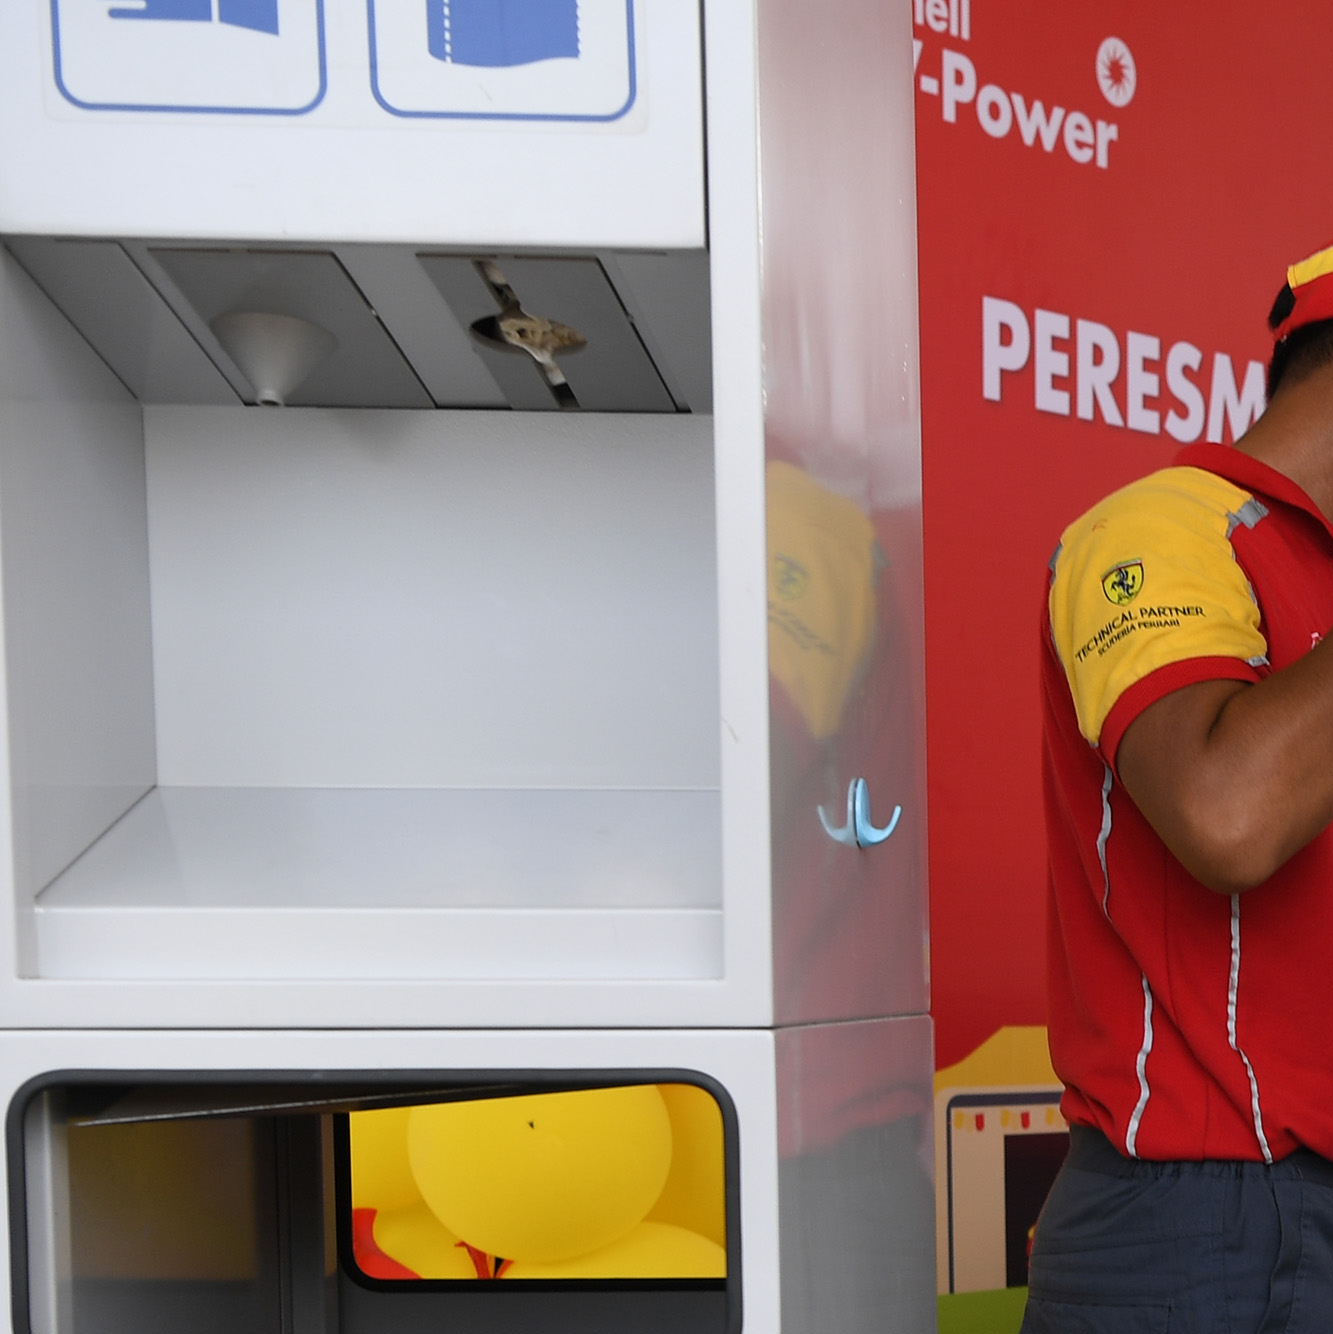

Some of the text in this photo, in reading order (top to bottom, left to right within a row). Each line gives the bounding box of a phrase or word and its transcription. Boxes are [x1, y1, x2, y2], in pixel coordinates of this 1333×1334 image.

[1074, 605, 1206, 664] TECHNICAL PARTNER
[1097, 624, 1137, 657] SCUDERIA
